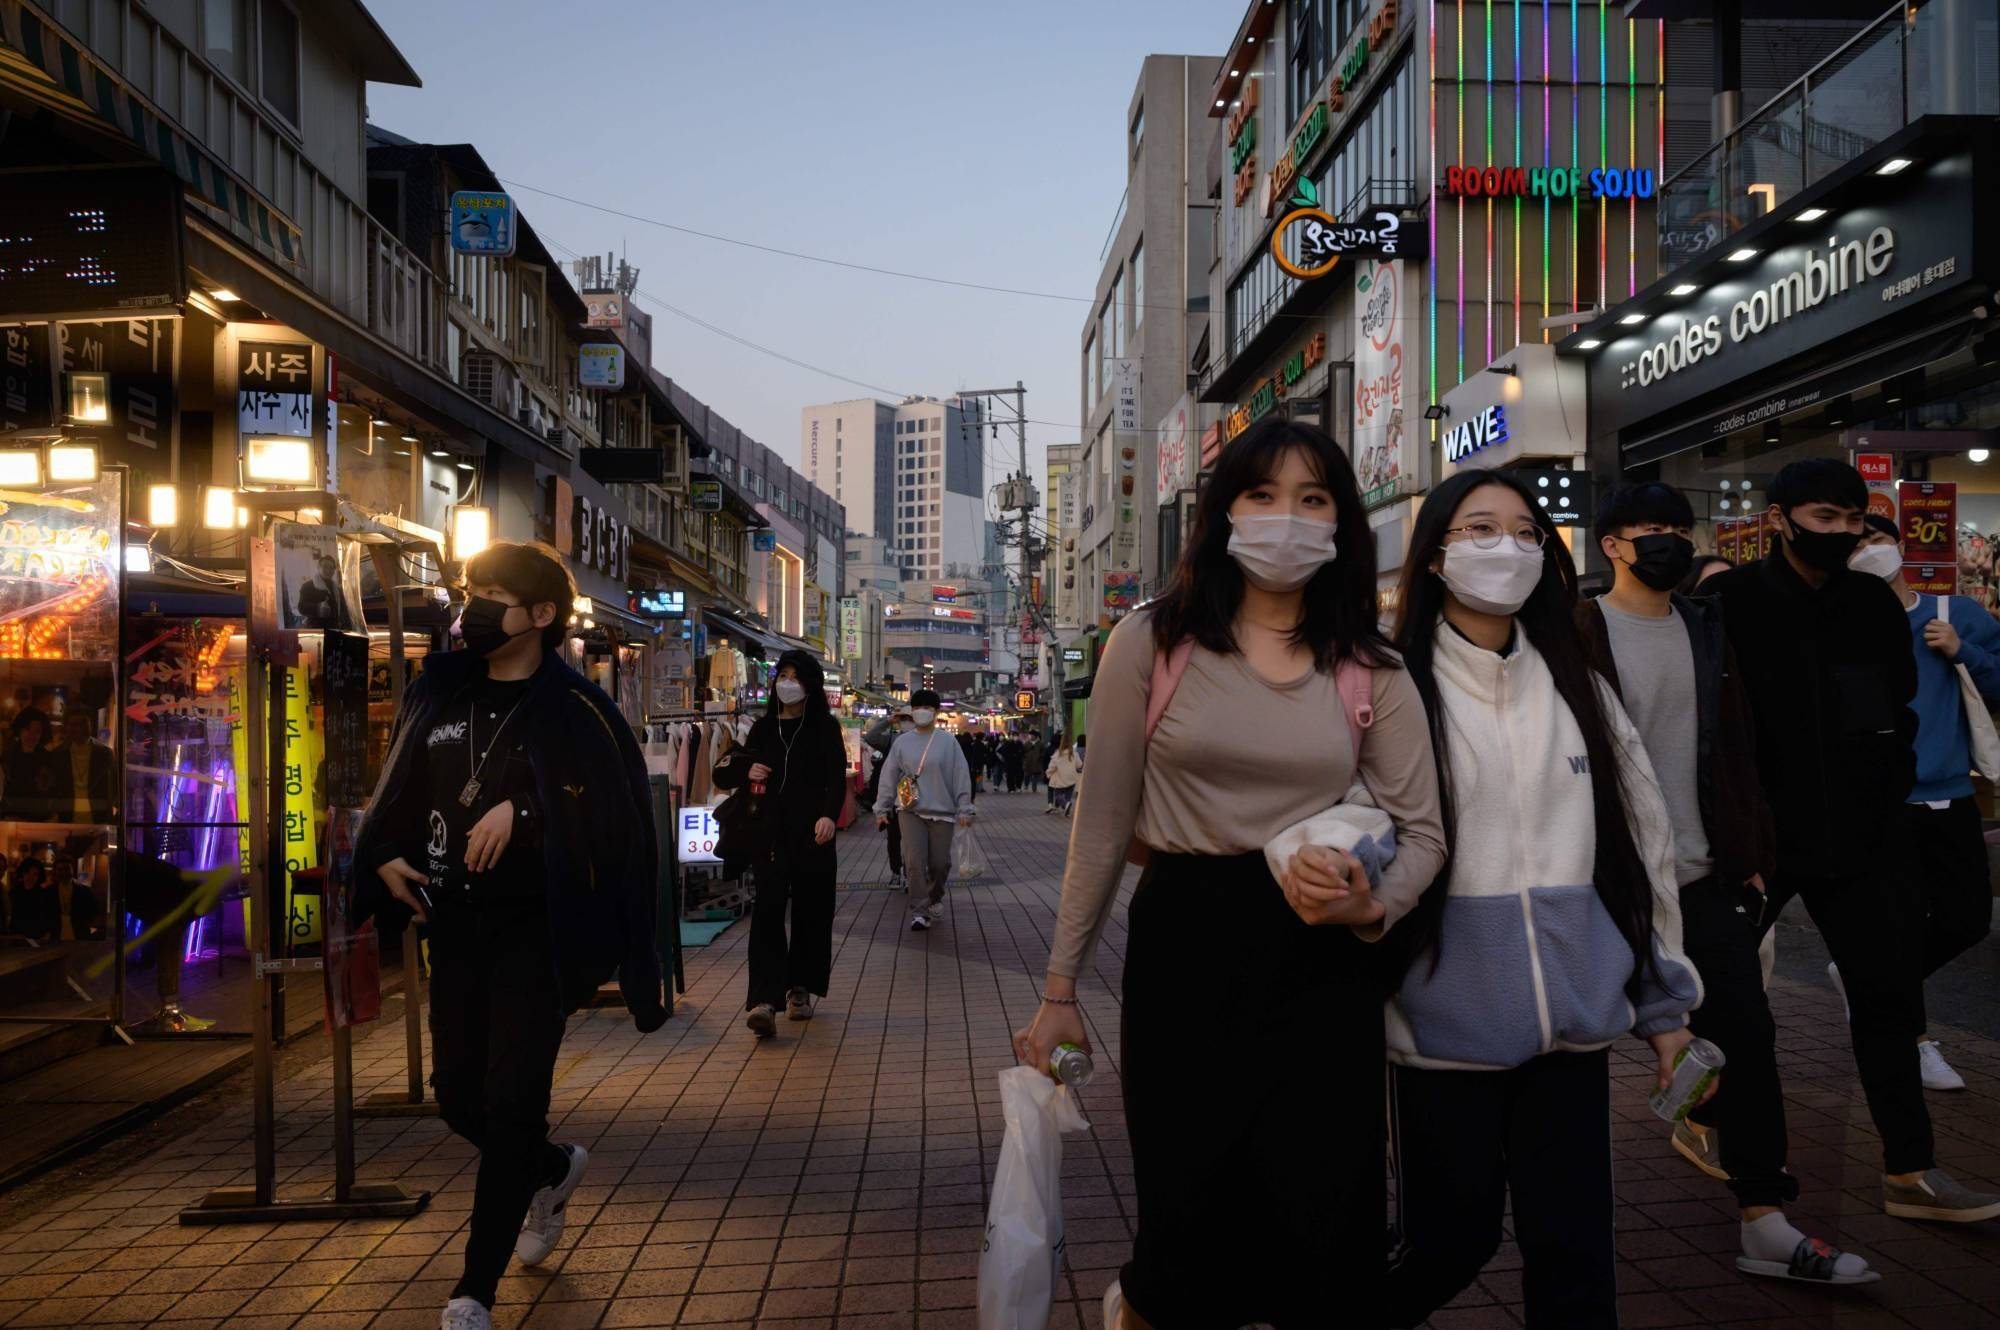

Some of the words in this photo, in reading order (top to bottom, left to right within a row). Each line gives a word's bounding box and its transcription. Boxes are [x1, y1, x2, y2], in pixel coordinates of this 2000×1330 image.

[1447, 165, 1526, 197] ROOM
[1530, 166, 1582, 198] HOF
[1590, 166, 1653, 199] SOJU
[1637, 314, 1722, 388] codes
[1729, 226, 1895, 343] combine
[244, 352, 308, 384] 사주
[1442, 404, 1505, 463] WAVE
[1719, 413, 1746, 433] codes
[1747, 398, 1786, 423] combine
[811, 420, 819, 467] Mercure
